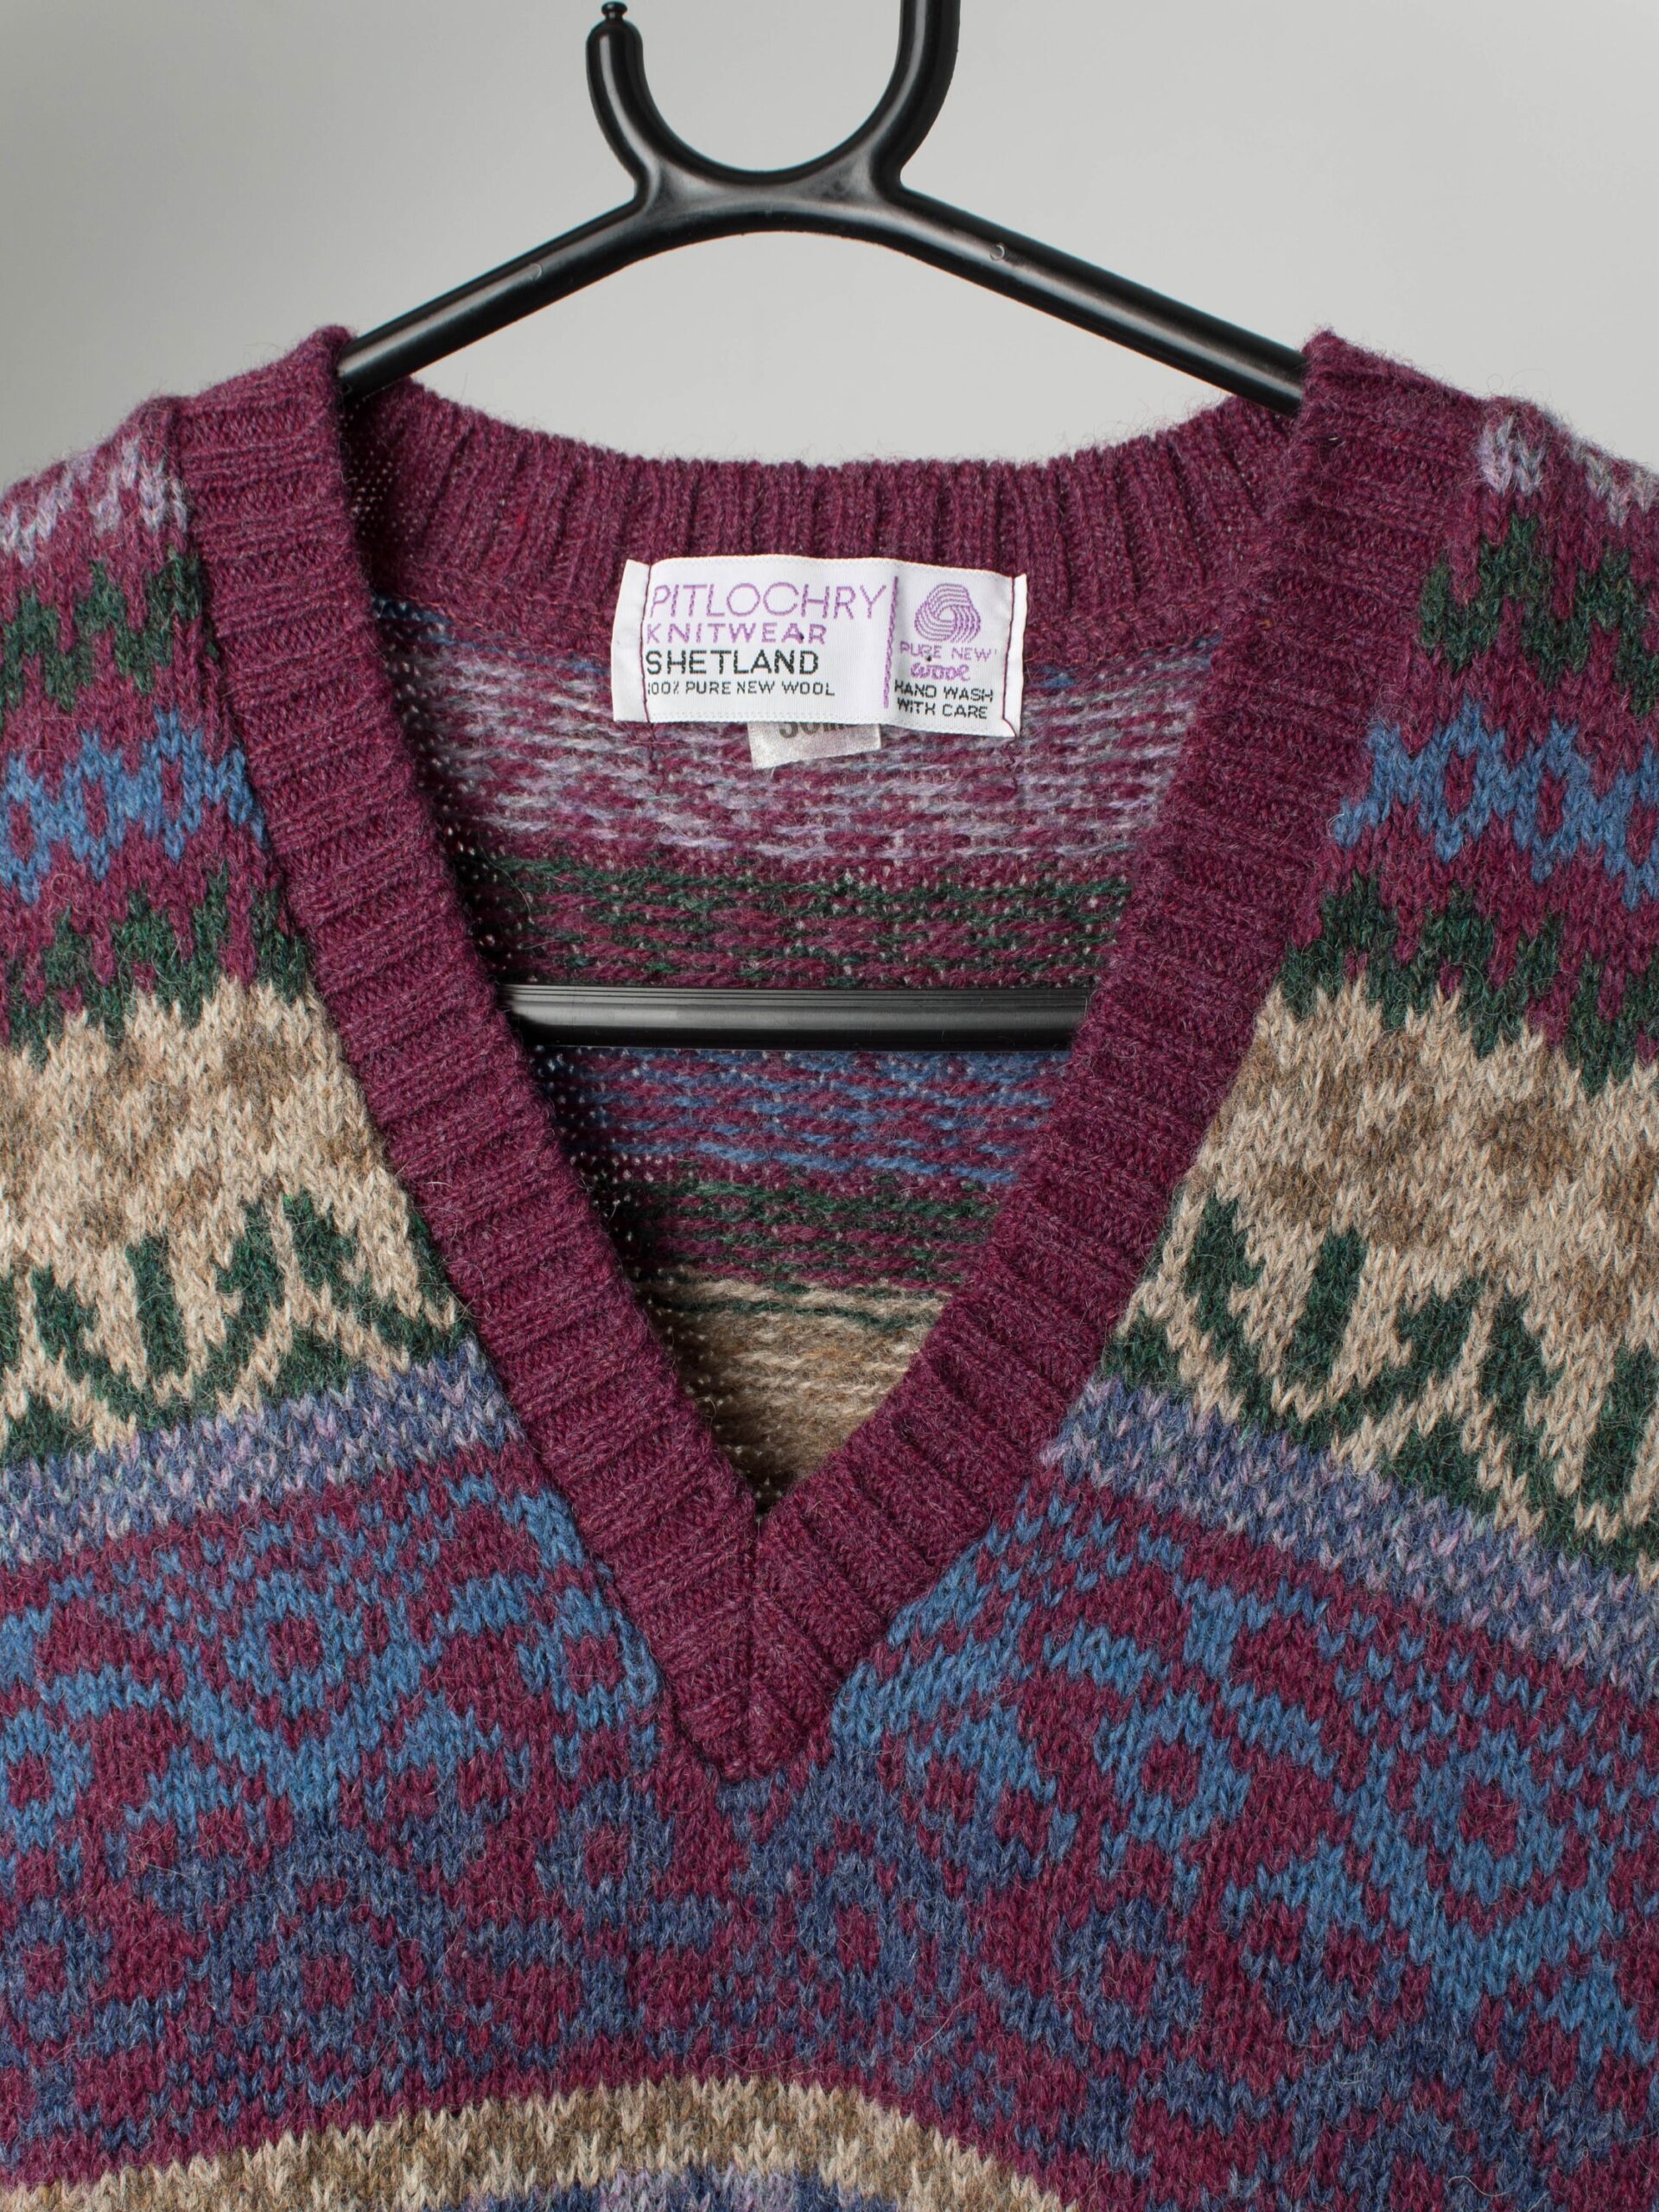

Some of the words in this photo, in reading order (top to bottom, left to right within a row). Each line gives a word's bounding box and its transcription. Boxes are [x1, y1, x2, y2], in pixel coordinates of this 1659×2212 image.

[651, 582, 887, 620] PITLOCHRY
[646, 622, 828, 645] KNITWEAR
[645, 649, 819, 675] SHETLAND
[899, 640, 943, 660] PURE
[951, 646, 993, 663] NEW
[685, 681, 732, 696] PURE
[736, 681, 775, 695] NEW
[781, 682, 836, 696] WOOL
[894, 679, 938, 699] HAND
[943, 686, 994, 703] WASH
[897, 697, 936, 716] WITH
[942, 703, 988, 720] CARE
